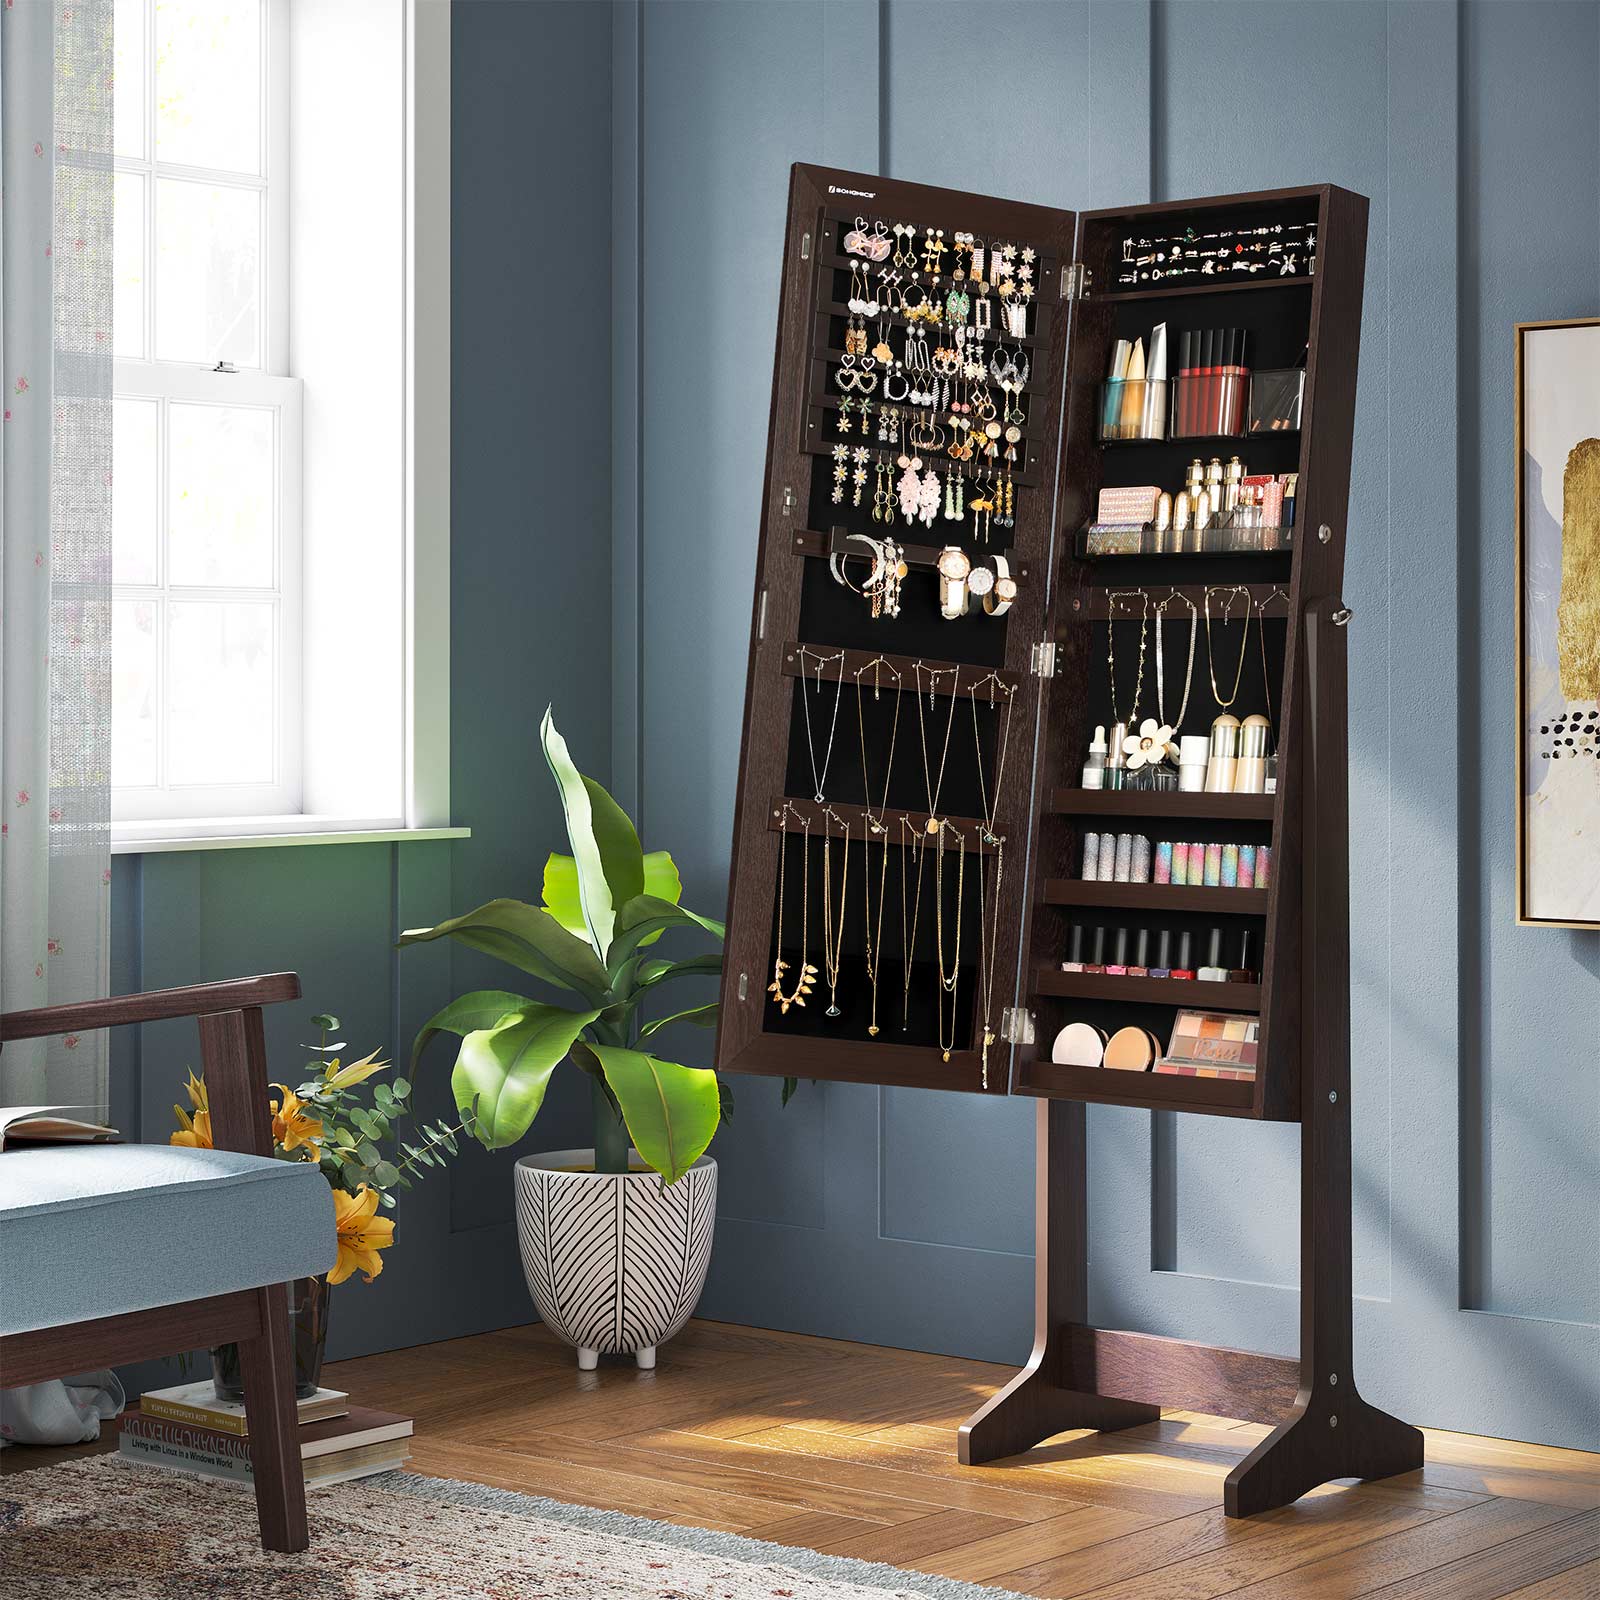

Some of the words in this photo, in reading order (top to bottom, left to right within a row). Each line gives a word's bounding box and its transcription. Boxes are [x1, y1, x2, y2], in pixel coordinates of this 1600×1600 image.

[132, 1439, 149, 1452] Living
[150, 1443, 162, 1453] with
[162, 1444, 178, 1457] Linux
[178, 1448, 186, 1458] in
[190, 1450, 215, 1465] Windows
[215, 1456, 233, 1469] World
